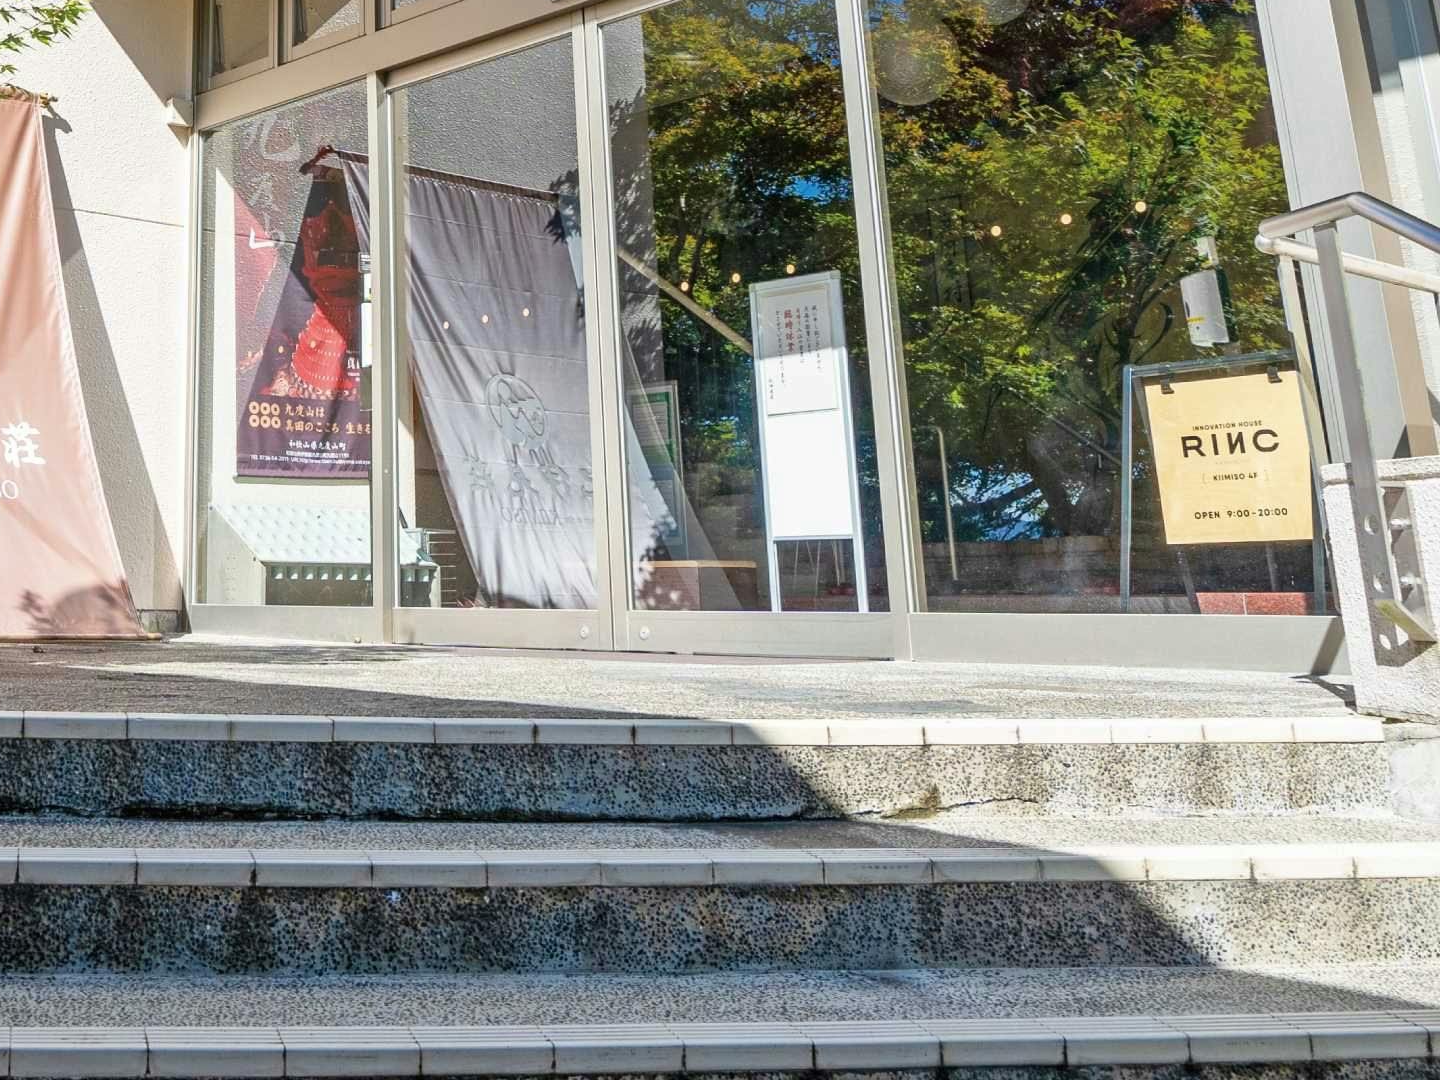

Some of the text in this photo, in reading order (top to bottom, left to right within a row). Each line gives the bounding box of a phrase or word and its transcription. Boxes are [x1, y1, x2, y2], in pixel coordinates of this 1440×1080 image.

[285, 403, 325, 417] 九度山は
[1192, 420, 1263, 431] INNOVATION HOUSE
[1213, 473, 1245, 481] KIIMISO
[1194, 507, 1288, 520] OPEN 9:00-20:00
